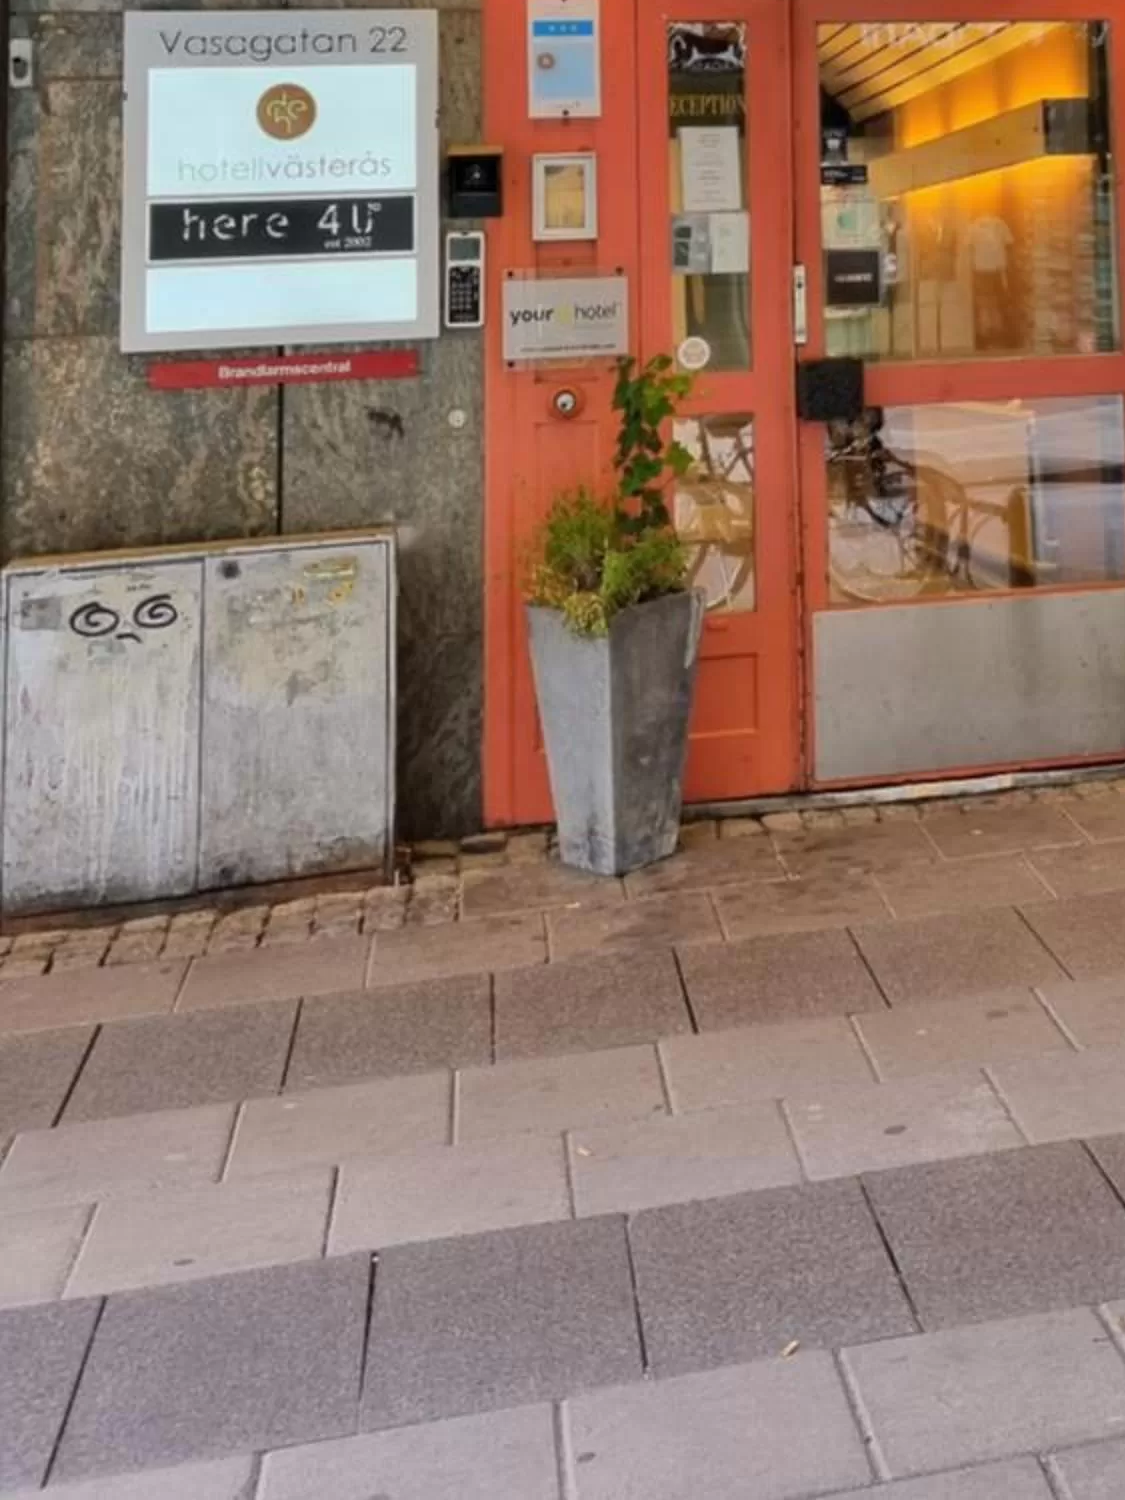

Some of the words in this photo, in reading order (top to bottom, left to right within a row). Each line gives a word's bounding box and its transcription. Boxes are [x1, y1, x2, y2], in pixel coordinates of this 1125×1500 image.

[159, 29, 357, 62] Vasagatan
[368, 25, 408, 53] 22
[177, 150, 391, 182] hotellvästerås
[182, 208, 289, 241] here
[509, 307, 554, 328] your
[574, 300, 618, 321] hotel
